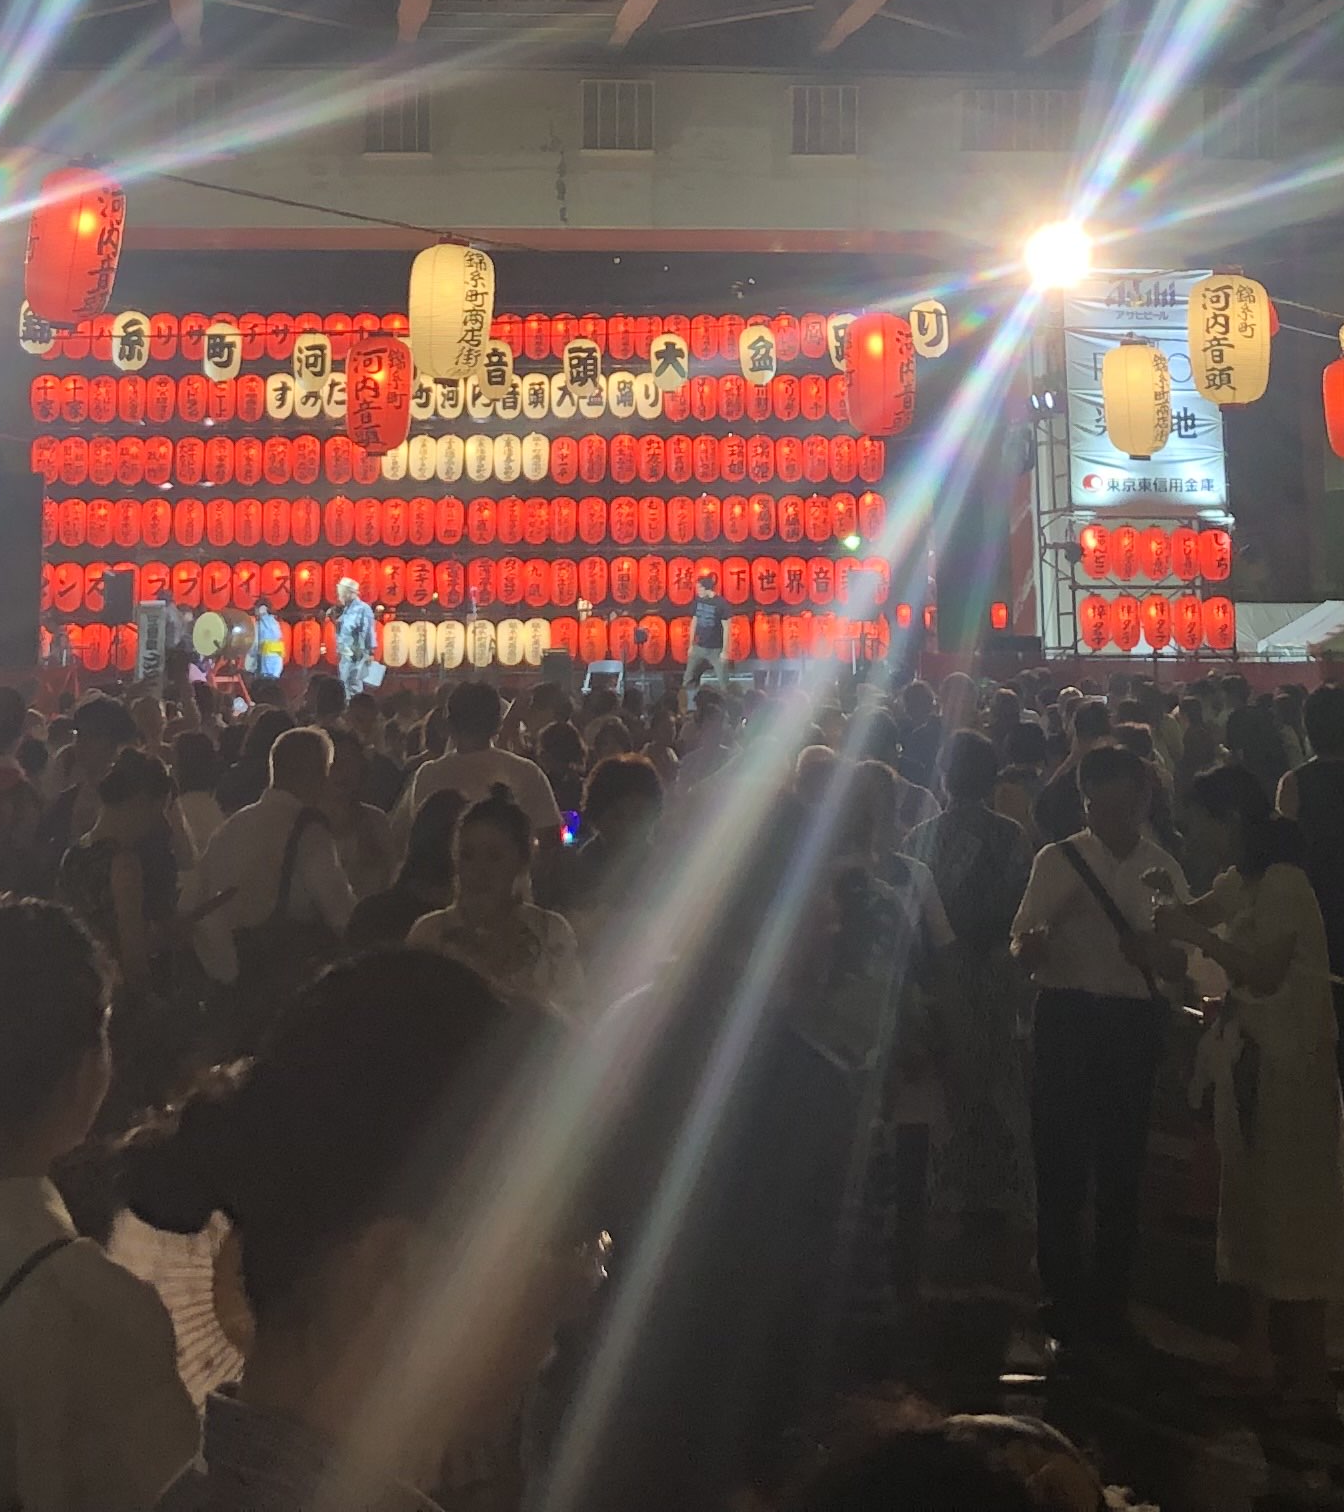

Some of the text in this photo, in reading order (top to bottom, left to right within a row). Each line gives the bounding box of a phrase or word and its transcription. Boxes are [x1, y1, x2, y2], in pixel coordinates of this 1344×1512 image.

[1201, 284, 1237, 391] 河内音頭
[1106, 476, 1215, 493] 東京東信用金庫
